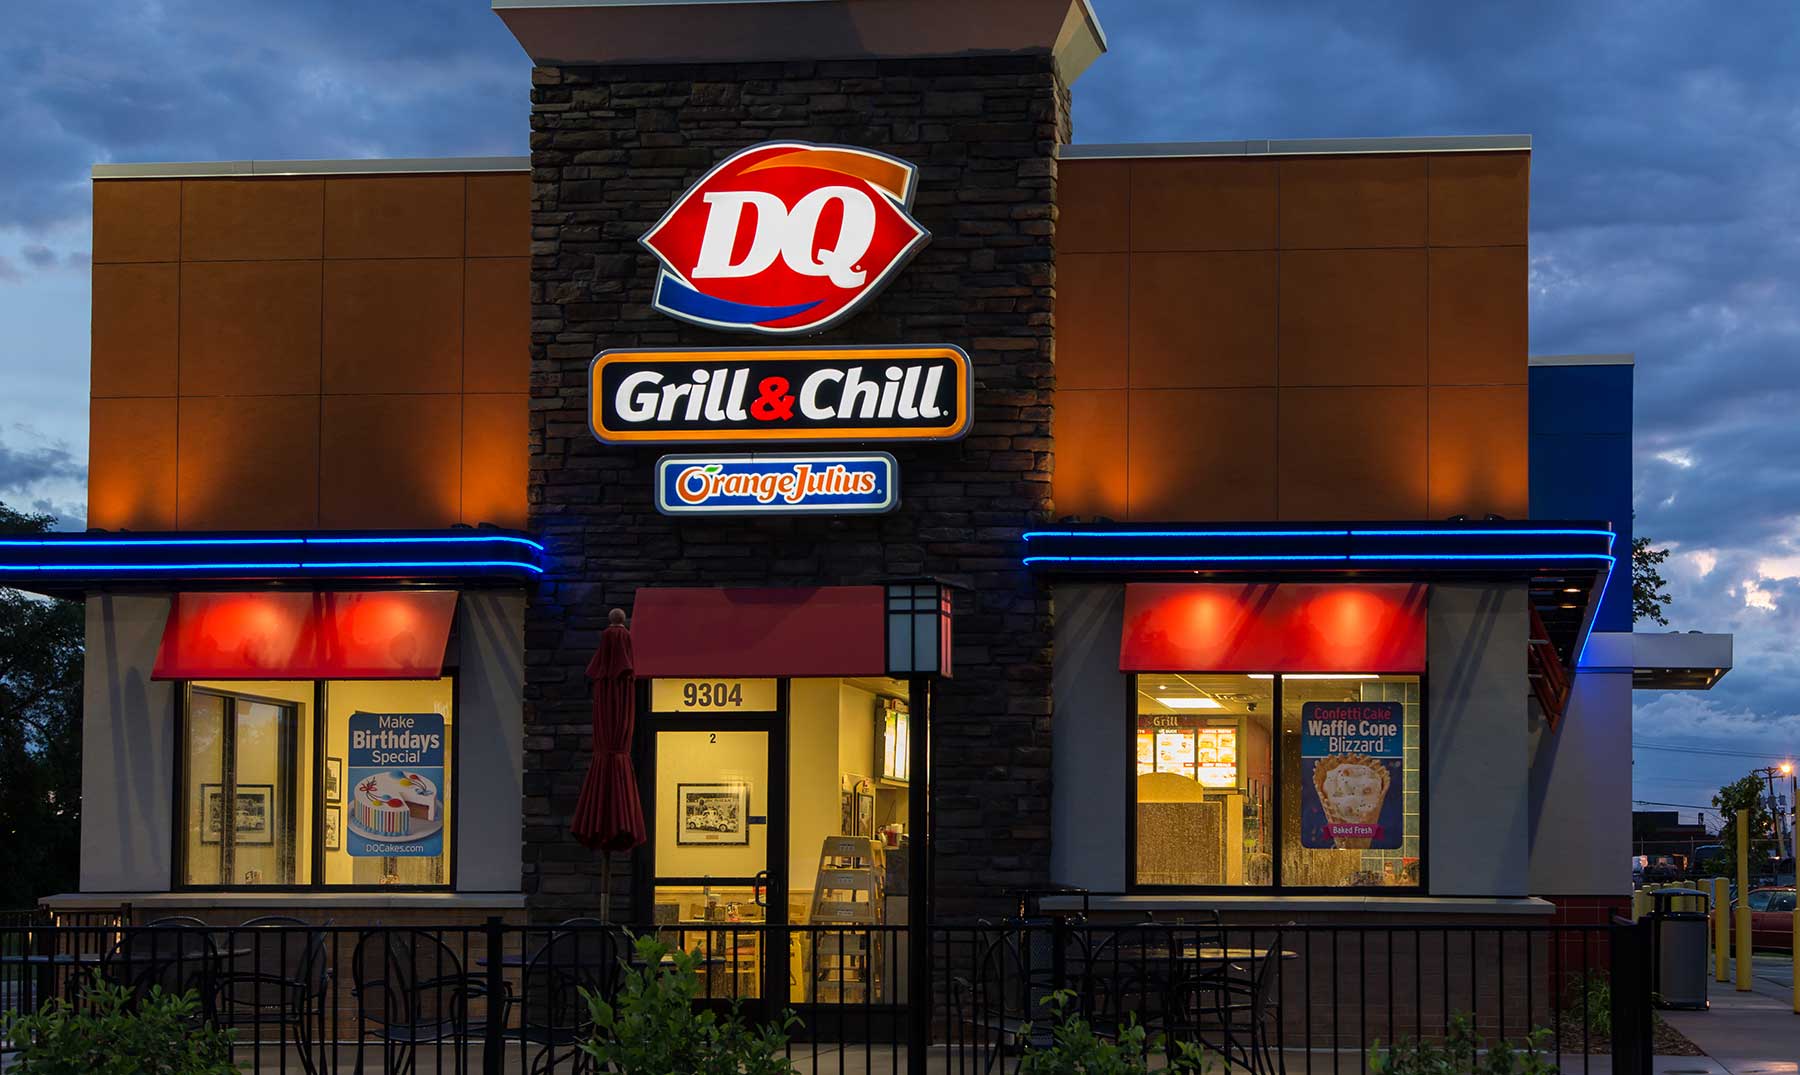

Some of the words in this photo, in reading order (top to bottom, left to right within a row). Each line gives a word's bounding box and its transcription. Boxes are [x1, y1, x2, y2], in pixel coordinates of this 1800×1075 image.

[691, 185, 877, 289] DQ
[683, 682, 743, 707] 9304
[1314, 707, 1361, 720] Confetti
[1363, 707, 1391, 720] Cake
[378, 715, 415, 729] Make
[1153, 716, 1178, 727] Grill
[1308, 720, 1356, 736] Waffle
[1359, 720, 1397, 736] Cone
[352, 730, 440, 753] Birthdays
[709, 733, 717, 744] 2
[1329, 736, 1384, 753] Blizzard
[371, 750, 421, 765] Special
[1332, 826, 1353, 835] Baked
[1354, 826, 1373, 835] Fresh
[365, 843, 424, 853] DQCakes.com
